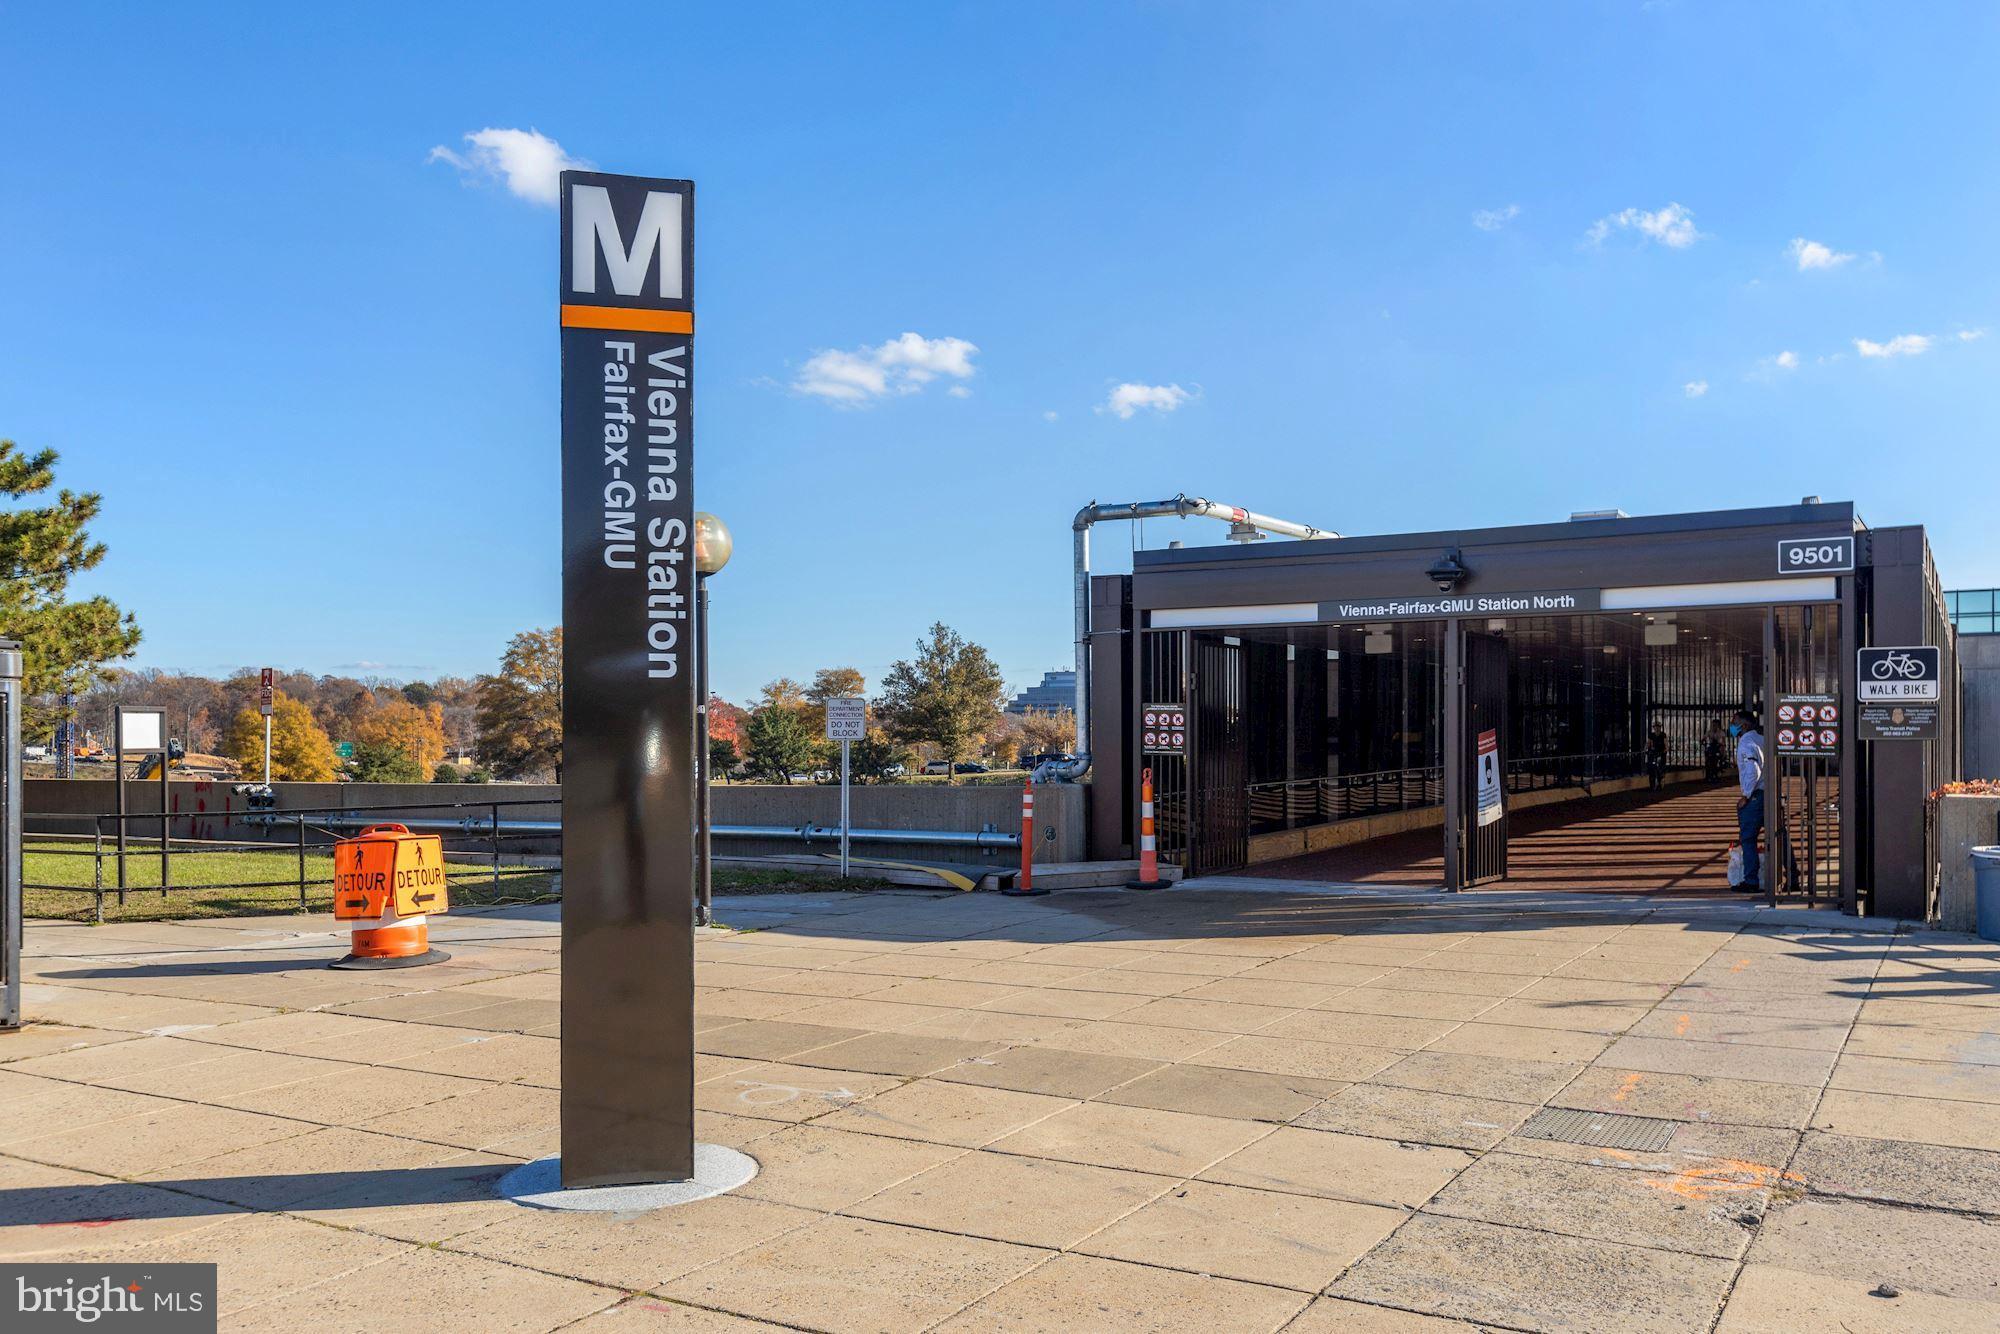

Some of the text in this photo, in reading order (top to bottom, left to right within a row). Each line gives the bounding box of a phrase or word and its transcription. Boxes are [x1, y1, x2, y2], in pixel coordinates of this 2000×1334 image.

[571, 184, 683, 300] M
[603, 341, 637, 570] Fairfax-GMU
[647, 345, 687, 680] Vienna Station
[1788, 545, 1844, 566] 9501
[1338, 595, 1575, 617] Vienna-Fairfax-GMU Station North
[1869, 684, 1928, 695] WALK BIKE
[337, 872, 386, 892] DETOUR
[397, 867, 442, 889] DETOUR
